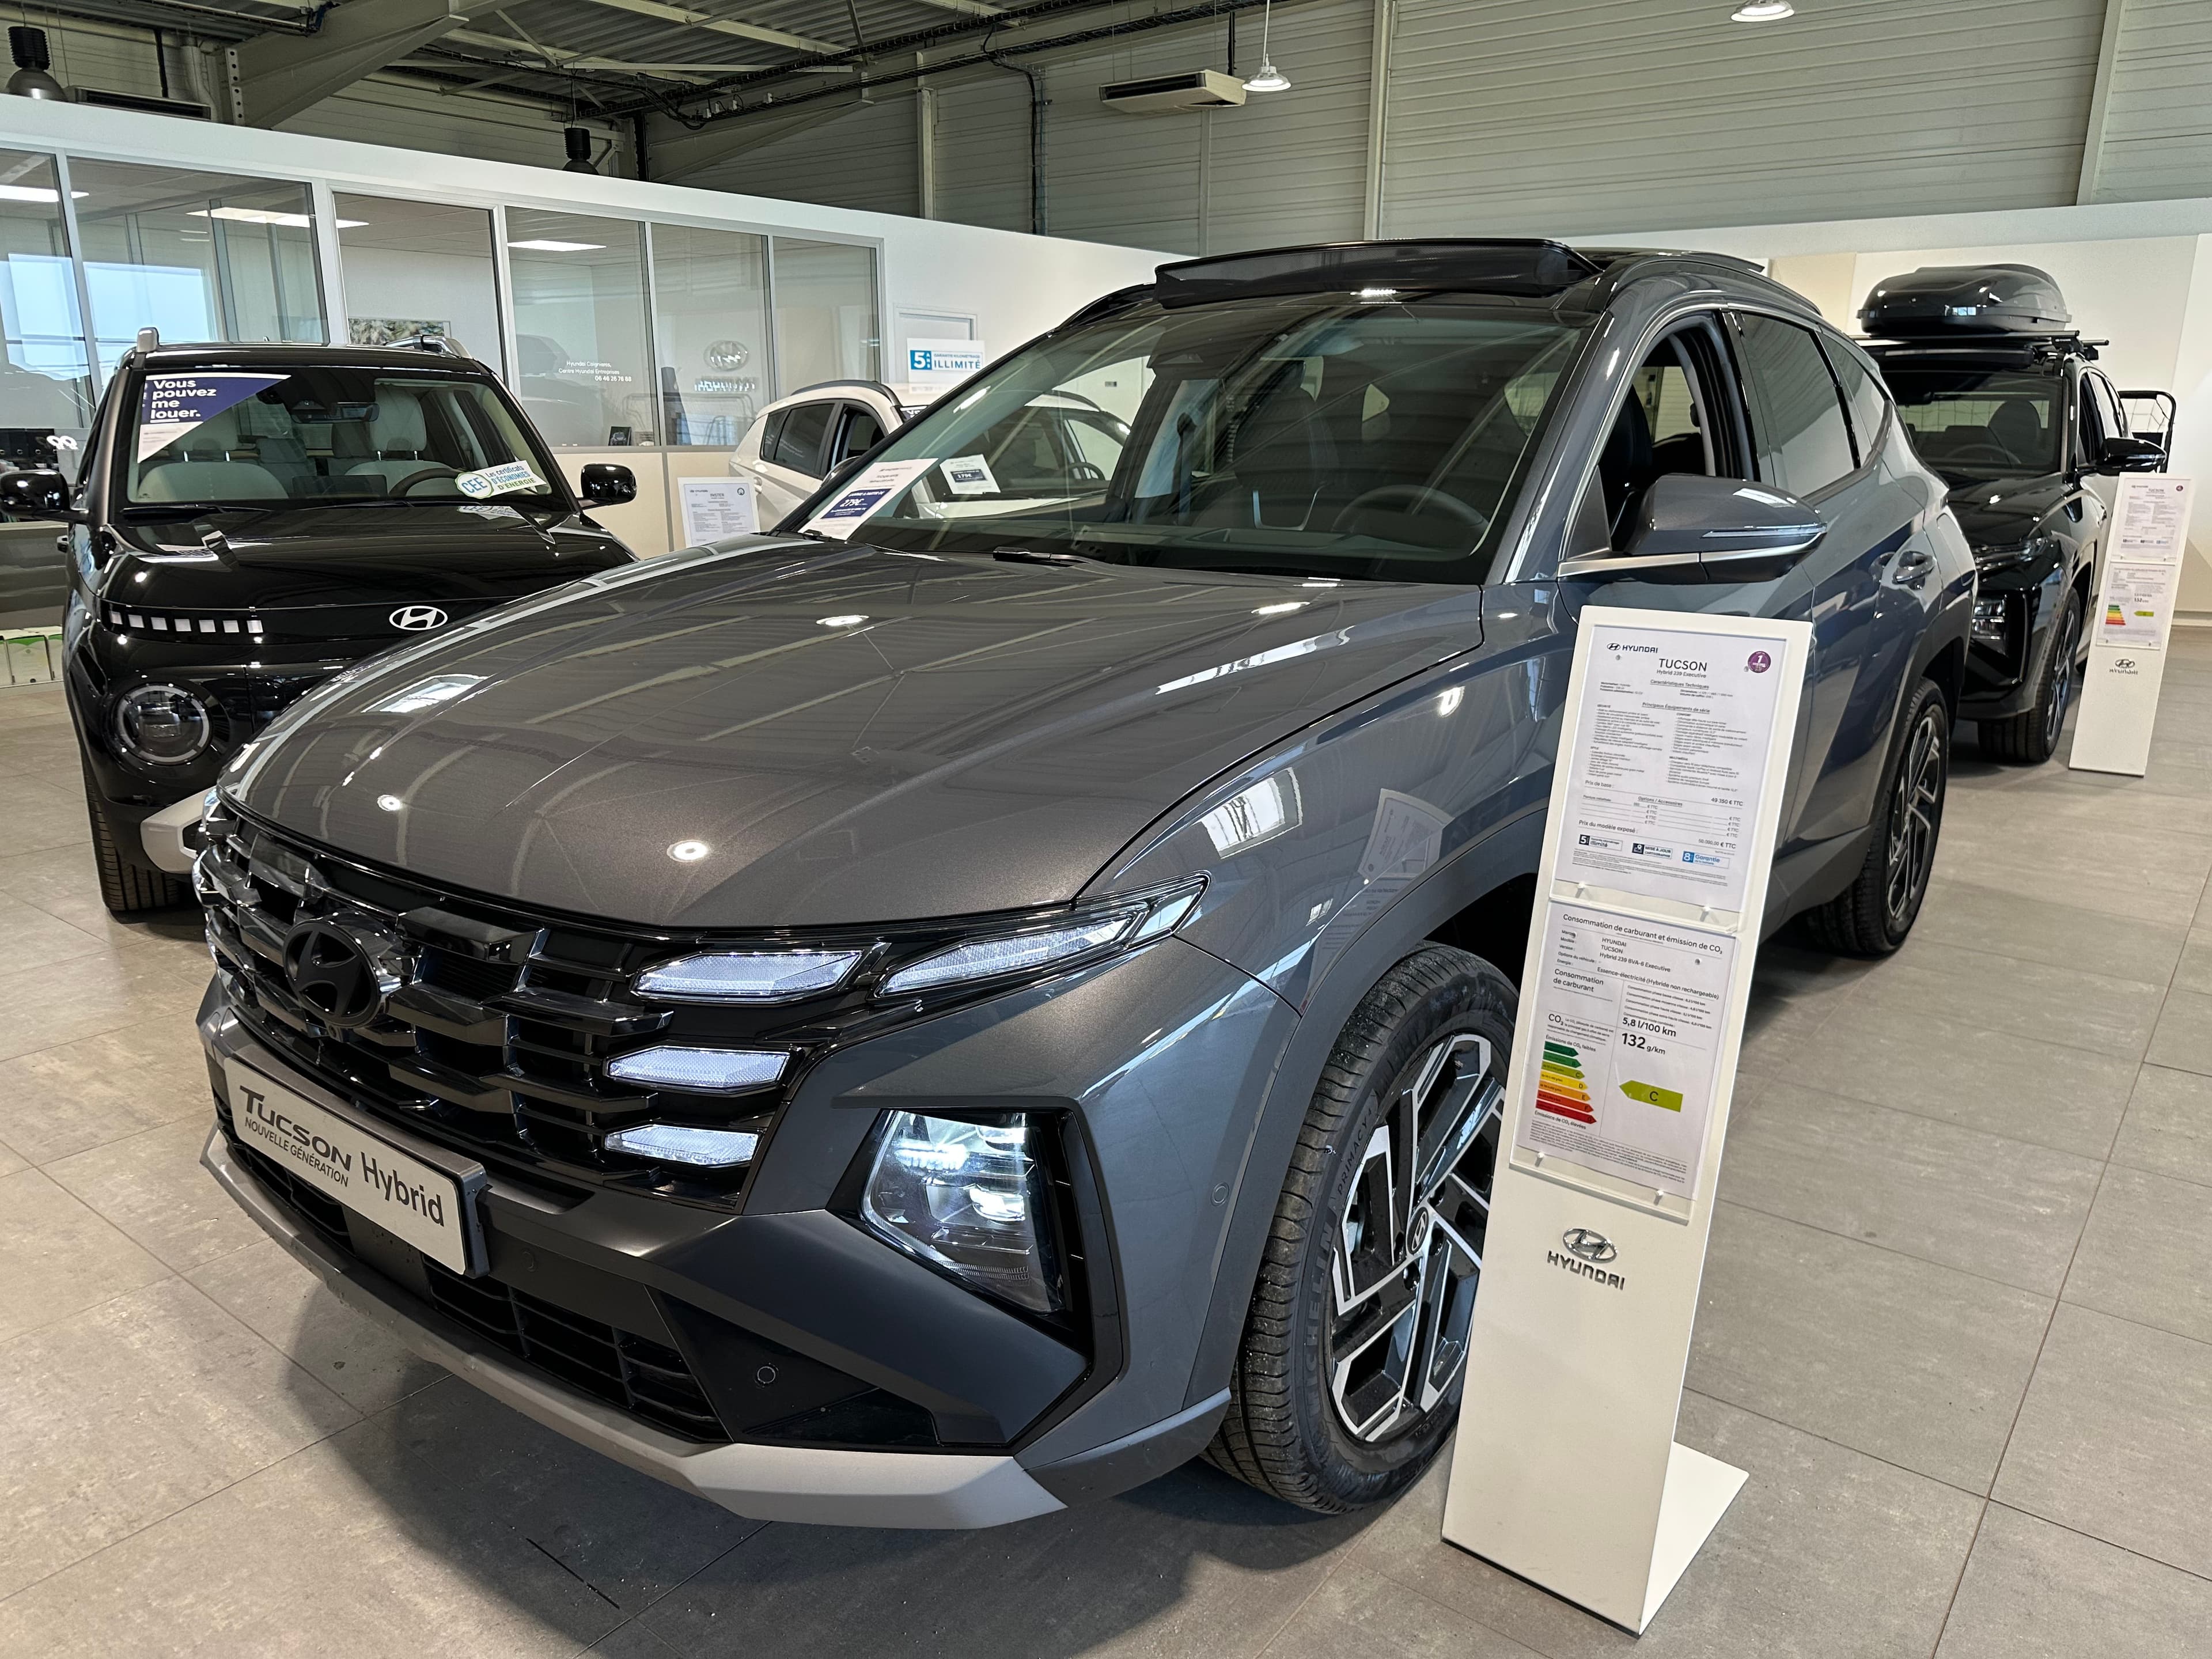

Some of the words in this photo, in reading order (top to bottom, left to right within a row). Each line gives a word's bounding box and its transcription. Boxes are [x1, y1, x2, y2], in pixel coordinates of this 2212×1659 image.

[914, 352, 926, 368] 5
[934, 359, 980, 369] ILLIMITÉ
[154, 380, 196, 389] Vous
[153, 388, 217, 399] pouvez
[151, 399, 180, 408] me
[150, 408, 201, 419] louer.
[497, 465, 524, 475] certificats
[461, 477, 488, 494] CEE
[840, 498, 865, 507] 279€
[1622, 645, 1658, 653] HYUNDAI
[1659, 658, 1707, 672] TUCSON
[1650, 679, 1684, 687] Caractéristiques
[1658, 798, 1683, 806] Accessoires
[1597, 823, 1616, 831] modèle
[1683, 853, 1691, 861] 8
[1695, 854, 1720, 863] Garantie
[1563, 914, 1612, 931] Consommation
[1613, 924, 1623, 932] de
[1623, 926, 1657, 940] carburant
[1666, 935, 1697, 948] émission
[1698, 942, 1708, 950] de
[1601, 937, 1627, 947] HYUNDAI
[1601, 945, 1623, 953] TUCSON
[1599, 952, 1616, 962] Hybrid
[1628, 958, 1644, 967] BVA-6
[1645, 962, 1671, 972] Executive
[1555, 968, 1604, 986] Consommation
[1562, 979, 1594, 993] carburant
[1597, 967, 1646, 983] Essence-électricité
[1646, 978, 1668, 990] (Hybride
[1681, 986, 1719, 1001] rechargeable)
[1622, 1017, 1635, 1027] 5,8
[1638, 1020, 1660, 1033] l/100
[1662, 1027, 1676, 1037] km
[1546, 1035, 1566, 1044] Émissions
[1622, 1032, 1646, 1050] 132
[1646, 1045, 1665, 1055] g/km
[1649, 1090, 1659, 1102] C
[1535, 1110, 1555, 1120] Émissions
[1570, 1120, 1586, 1130] élevées
[240, 1085, 351, 1171] TUCSON
[361, 1152, 445, 1228] Hybrid
[245, 1116, 289, 1152] NOUVELLE
[290, 1142, 349, 1187] GÉNÉRATION
[1338, 1116, 1368, 1195] PRIMACY
[1547, 1249, 1626, 1291] HYUNDAI
